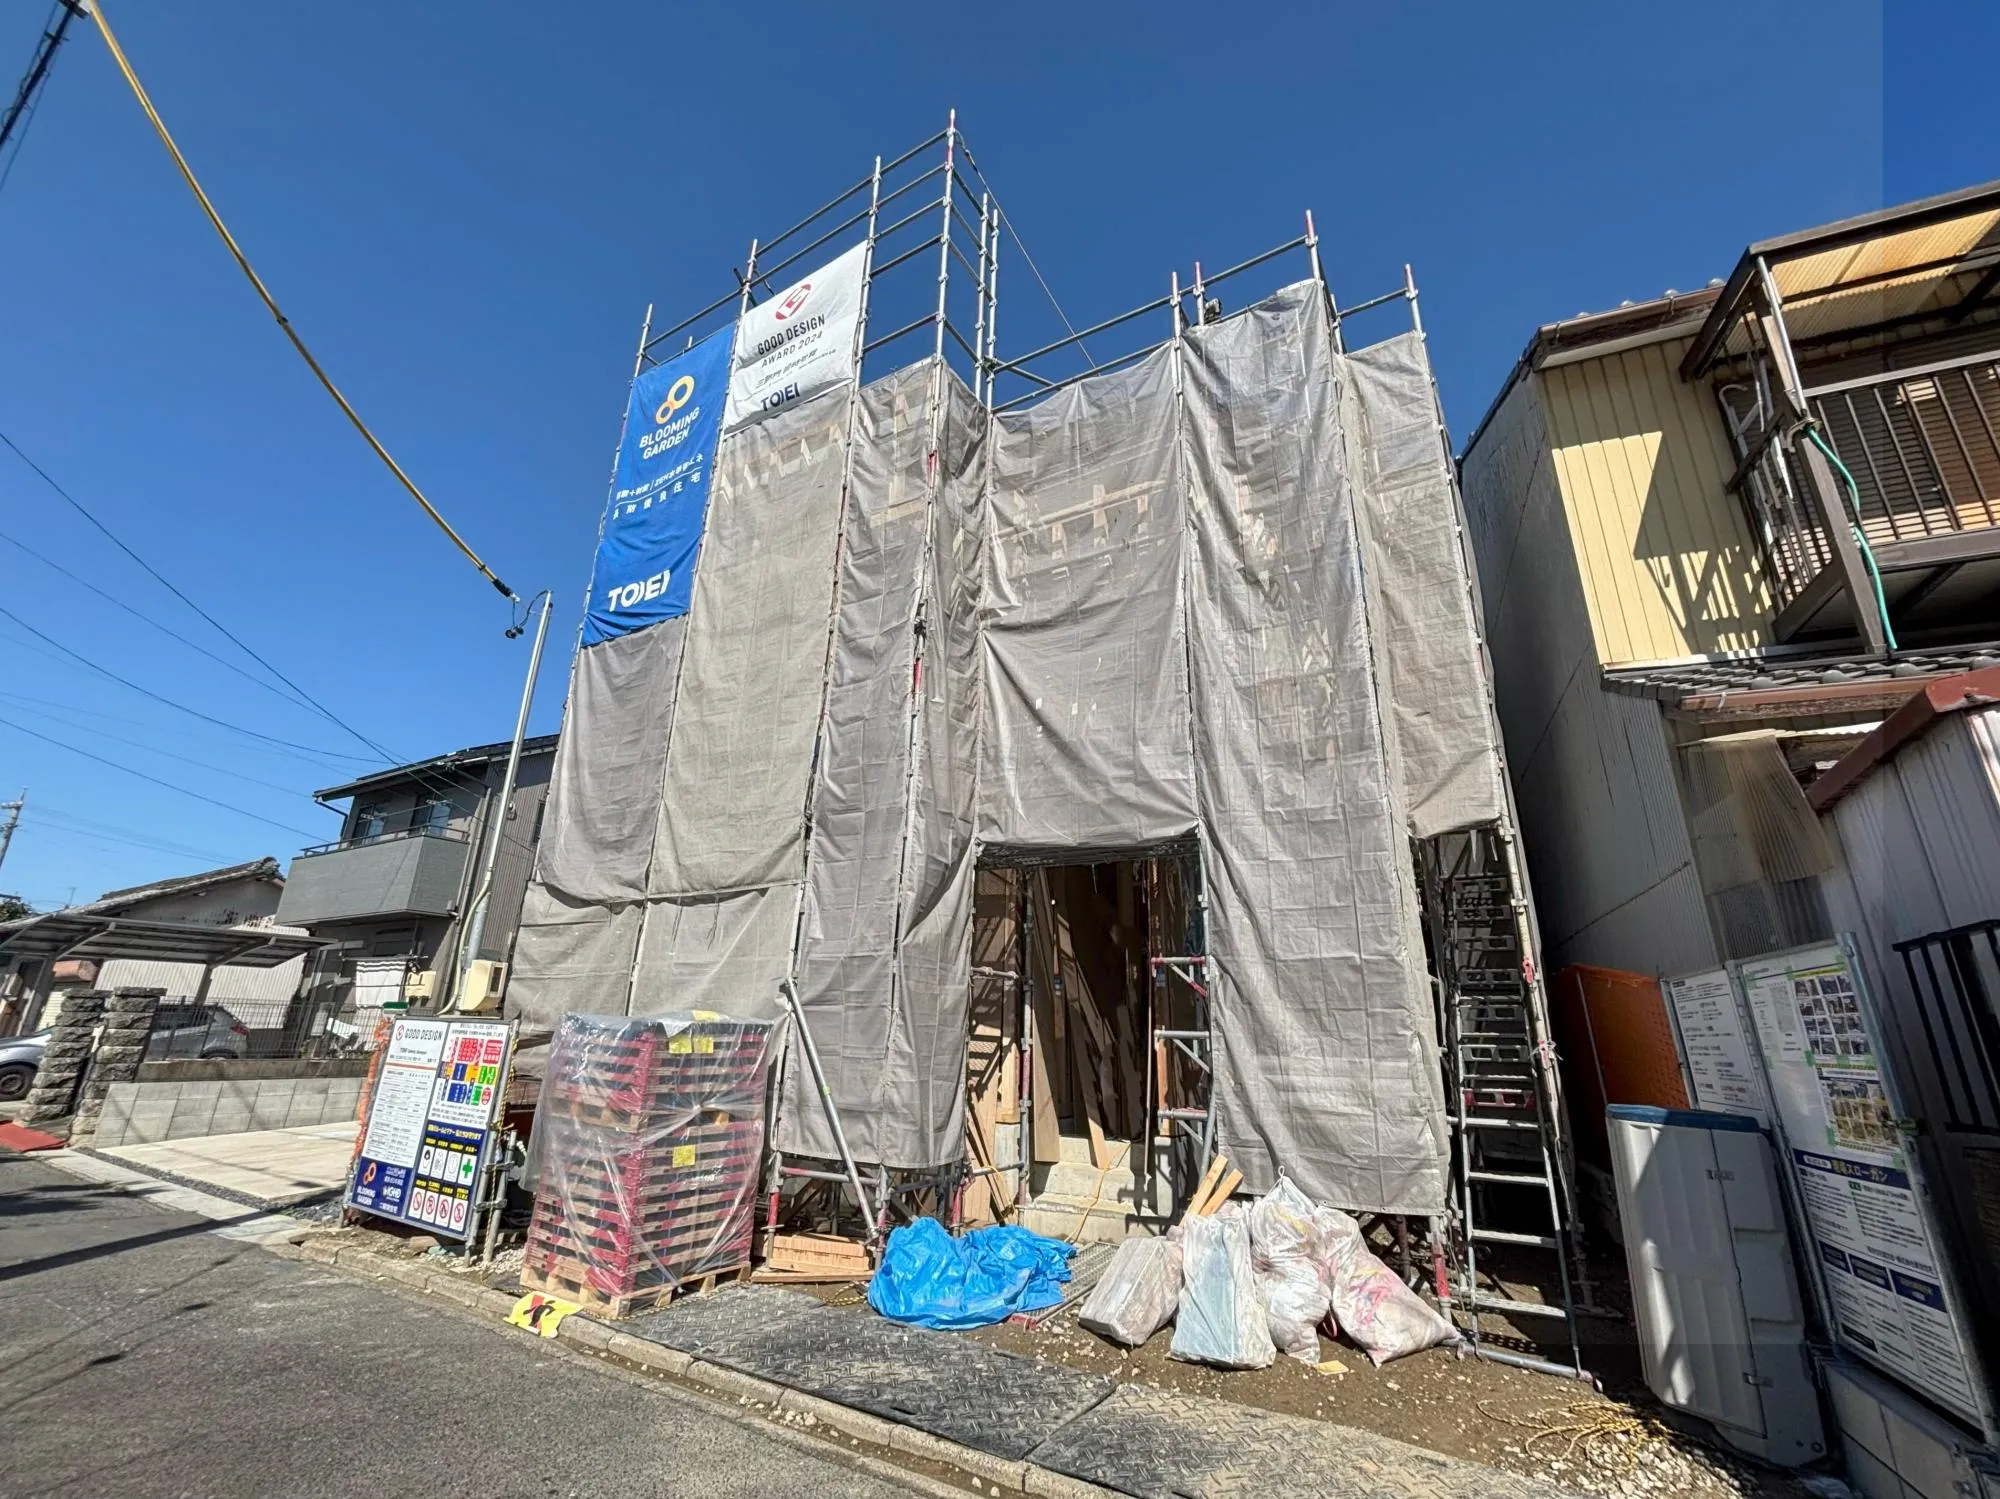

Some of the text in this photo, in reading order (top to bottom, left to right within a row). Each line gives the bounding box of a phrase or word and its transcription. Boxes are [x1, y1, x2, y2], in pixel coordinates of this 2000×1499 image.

[757, 314, 825, 355] GOOD DESIGN
[762, 345, 796, 368] AWARD
[798, 331, 823, 350] 2024
[760, 382, 801, 412] TOEI
[640, 406, 700, 448] BLOOMING
[643, 426, 691, 460] GARDEN
[607, 569, 672, 612] TOEI
[404, 1028, 421, 1040] GOOD
[420, 1029, 443, 1041] DESIGN
